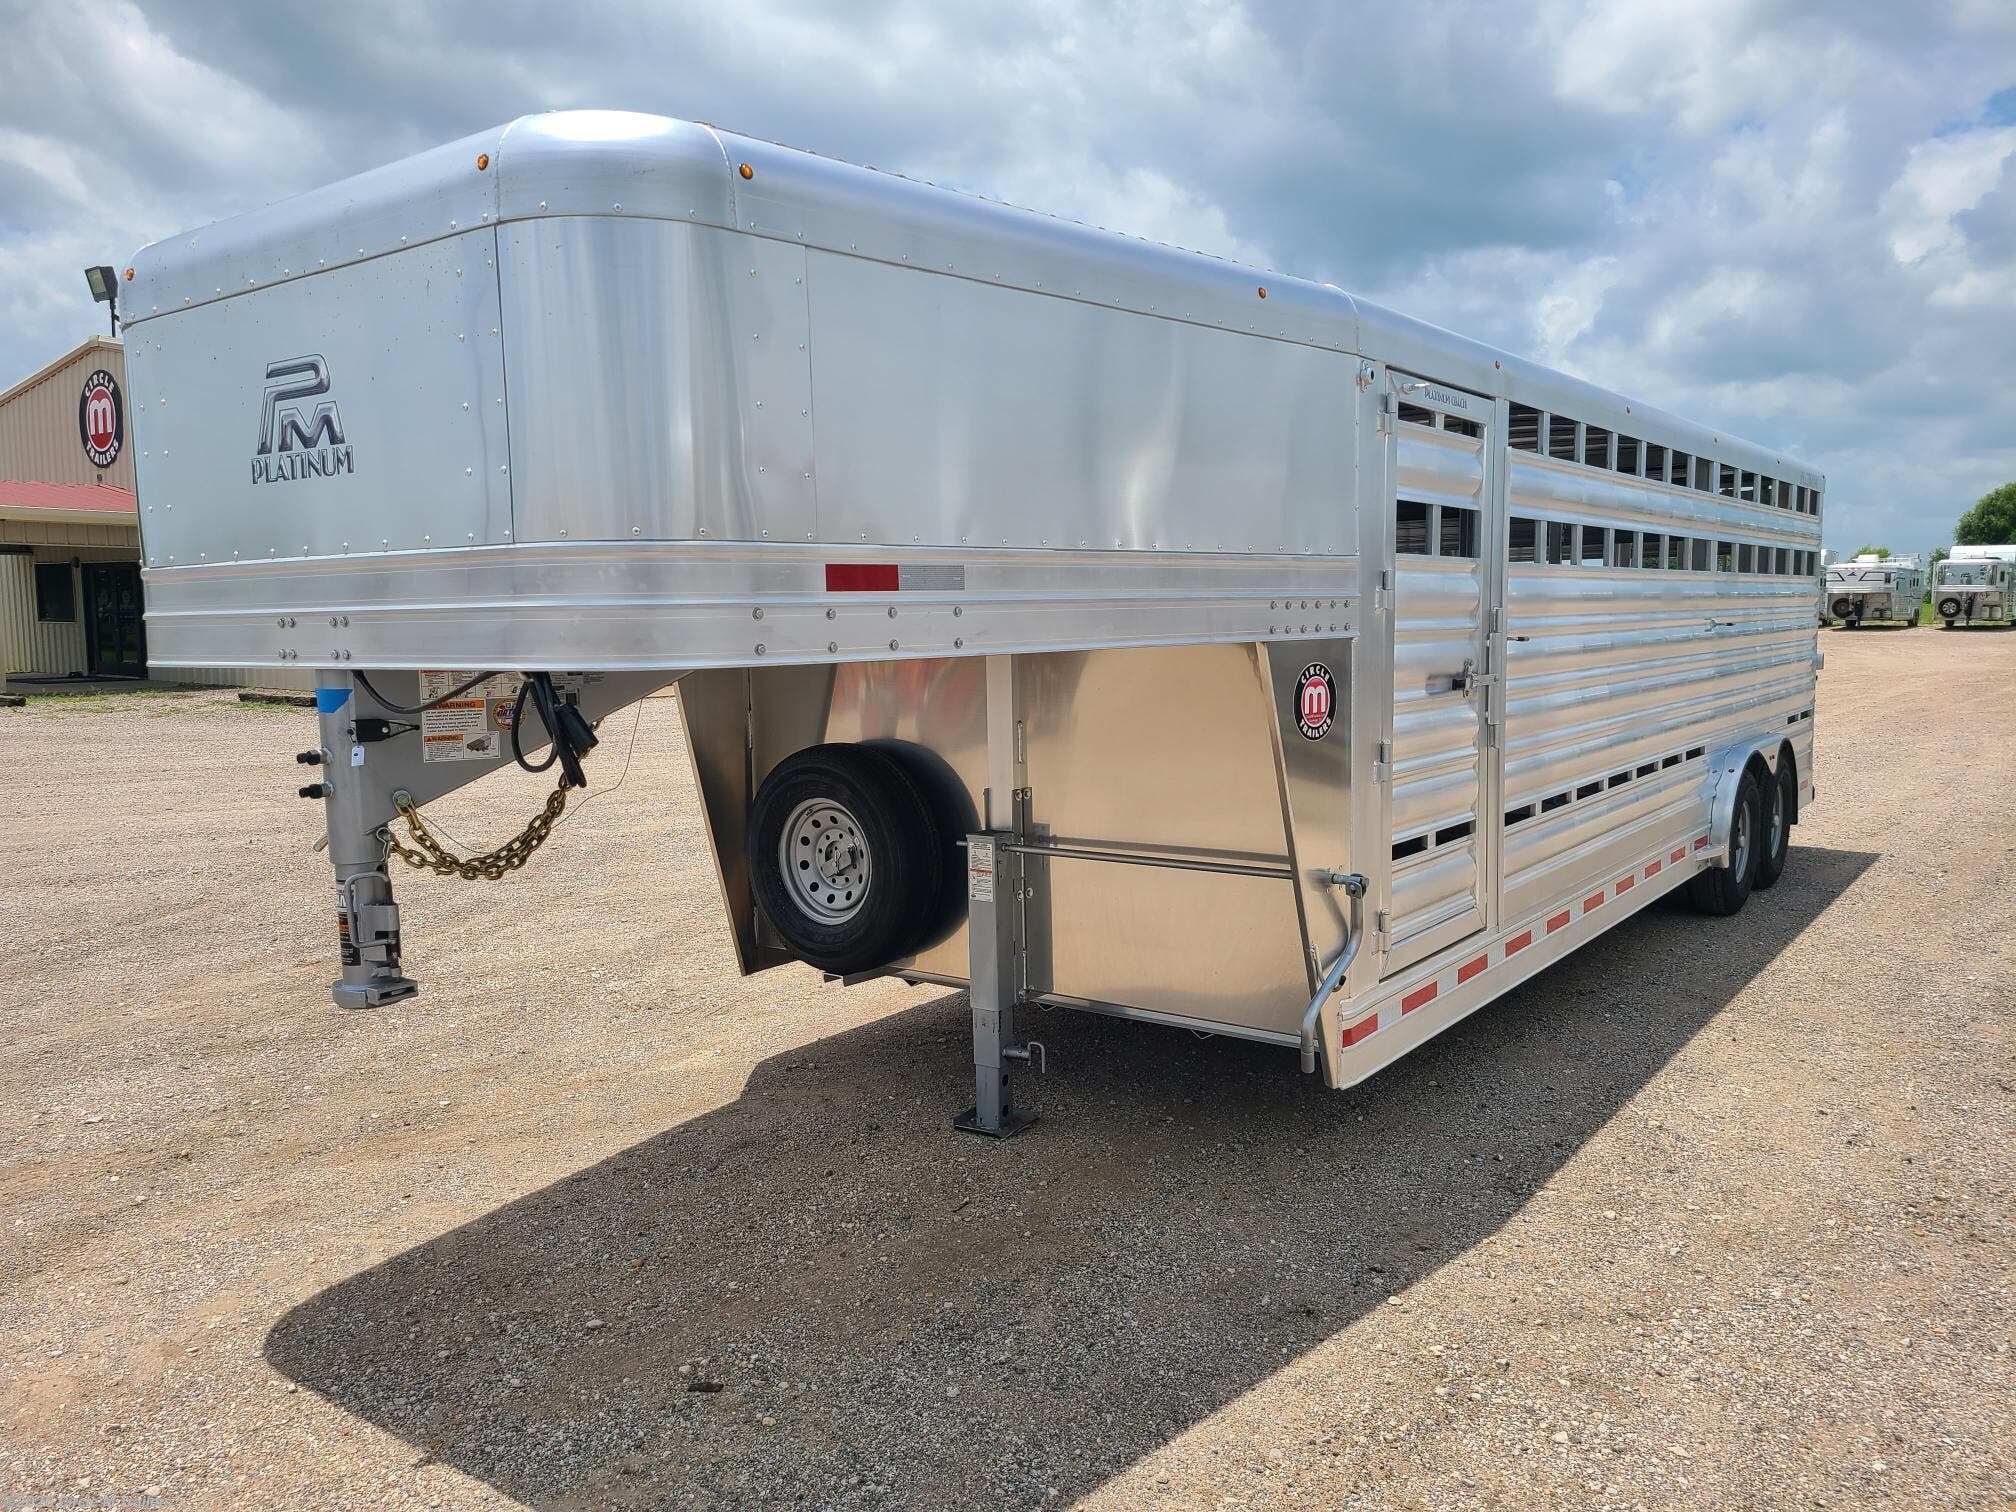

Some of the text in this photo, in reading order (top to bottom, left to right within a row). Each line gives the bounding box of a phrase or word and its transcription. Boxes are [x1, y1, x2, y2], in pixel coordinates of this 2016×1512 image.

[85, 372, 114, 397] CIRCLE
[86, 438, 119, 465] TRAILERS
[250, 444, 355, 485] PLATINUM
[1301, 665, 1330, 684] CIRCLE
[438, 701, 476, 709] WARNING
[1300, 717, 1331, 738] TRAILERS
